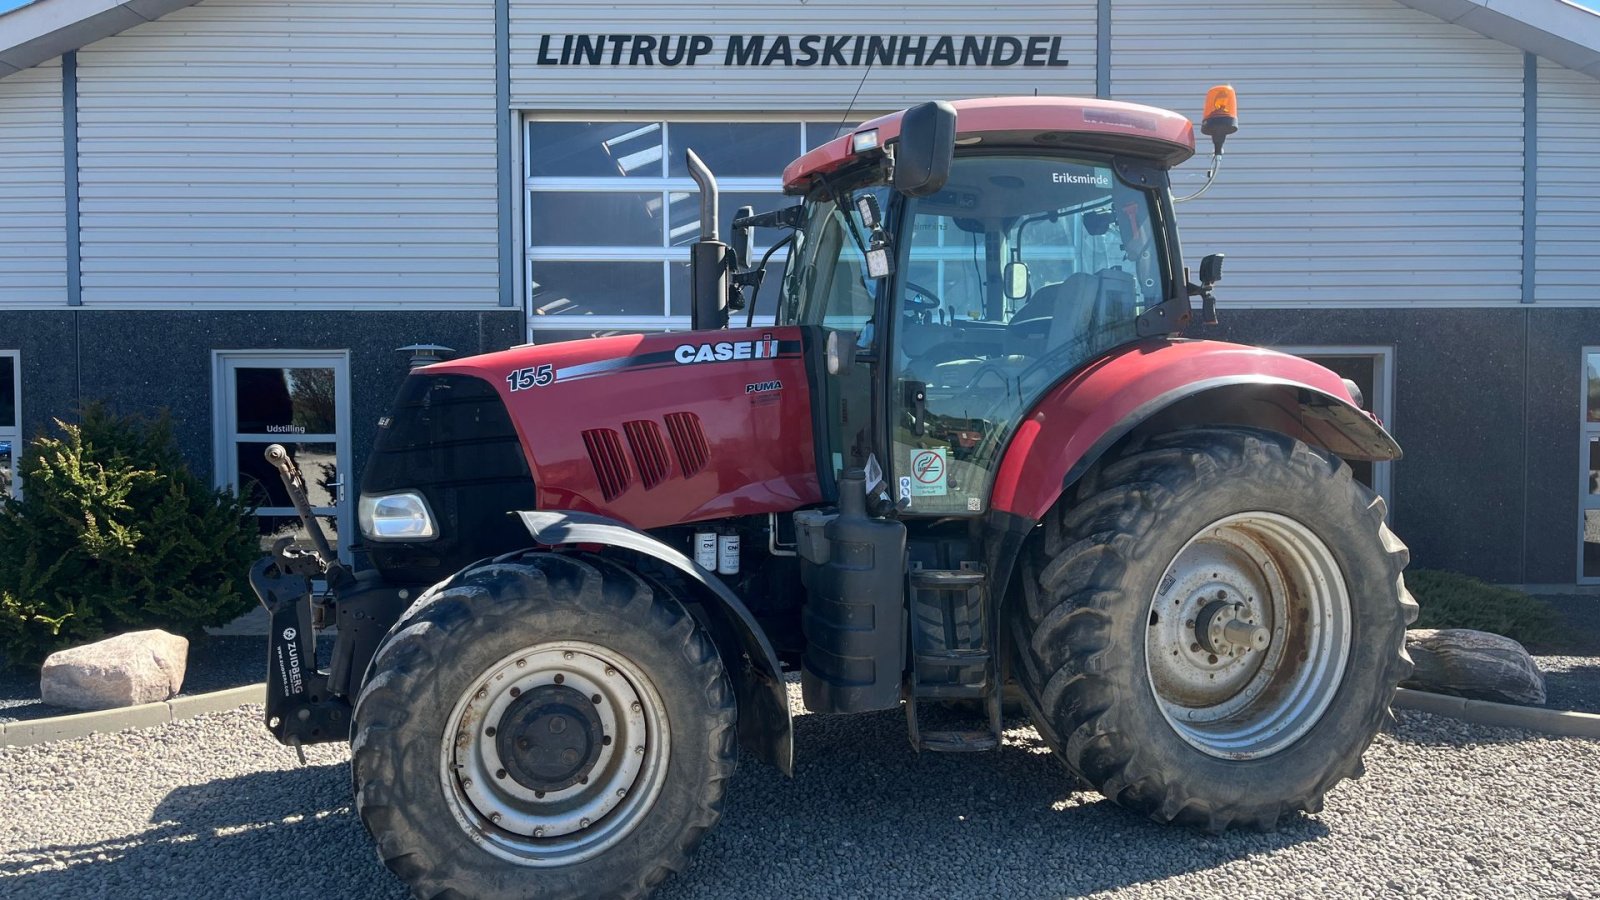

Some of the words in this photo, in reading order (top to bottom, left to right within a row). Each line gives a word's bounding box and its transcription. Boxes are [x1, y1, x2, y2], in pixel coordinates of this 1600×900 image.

[537, 35, 713, 66] LINTRUP
[724, 35, 1069, 67] MASKINHANDEL
[1052, 172, 1108, 185] Eriksminde
[674, 341, 752, 364] CASE
[506, 363, 554, 392] 155
[745, 380, 783, 394] PUMA
[266, 424, 306, 434] Udstilling
[287, 641, 303, 694] ZUIDBERG
